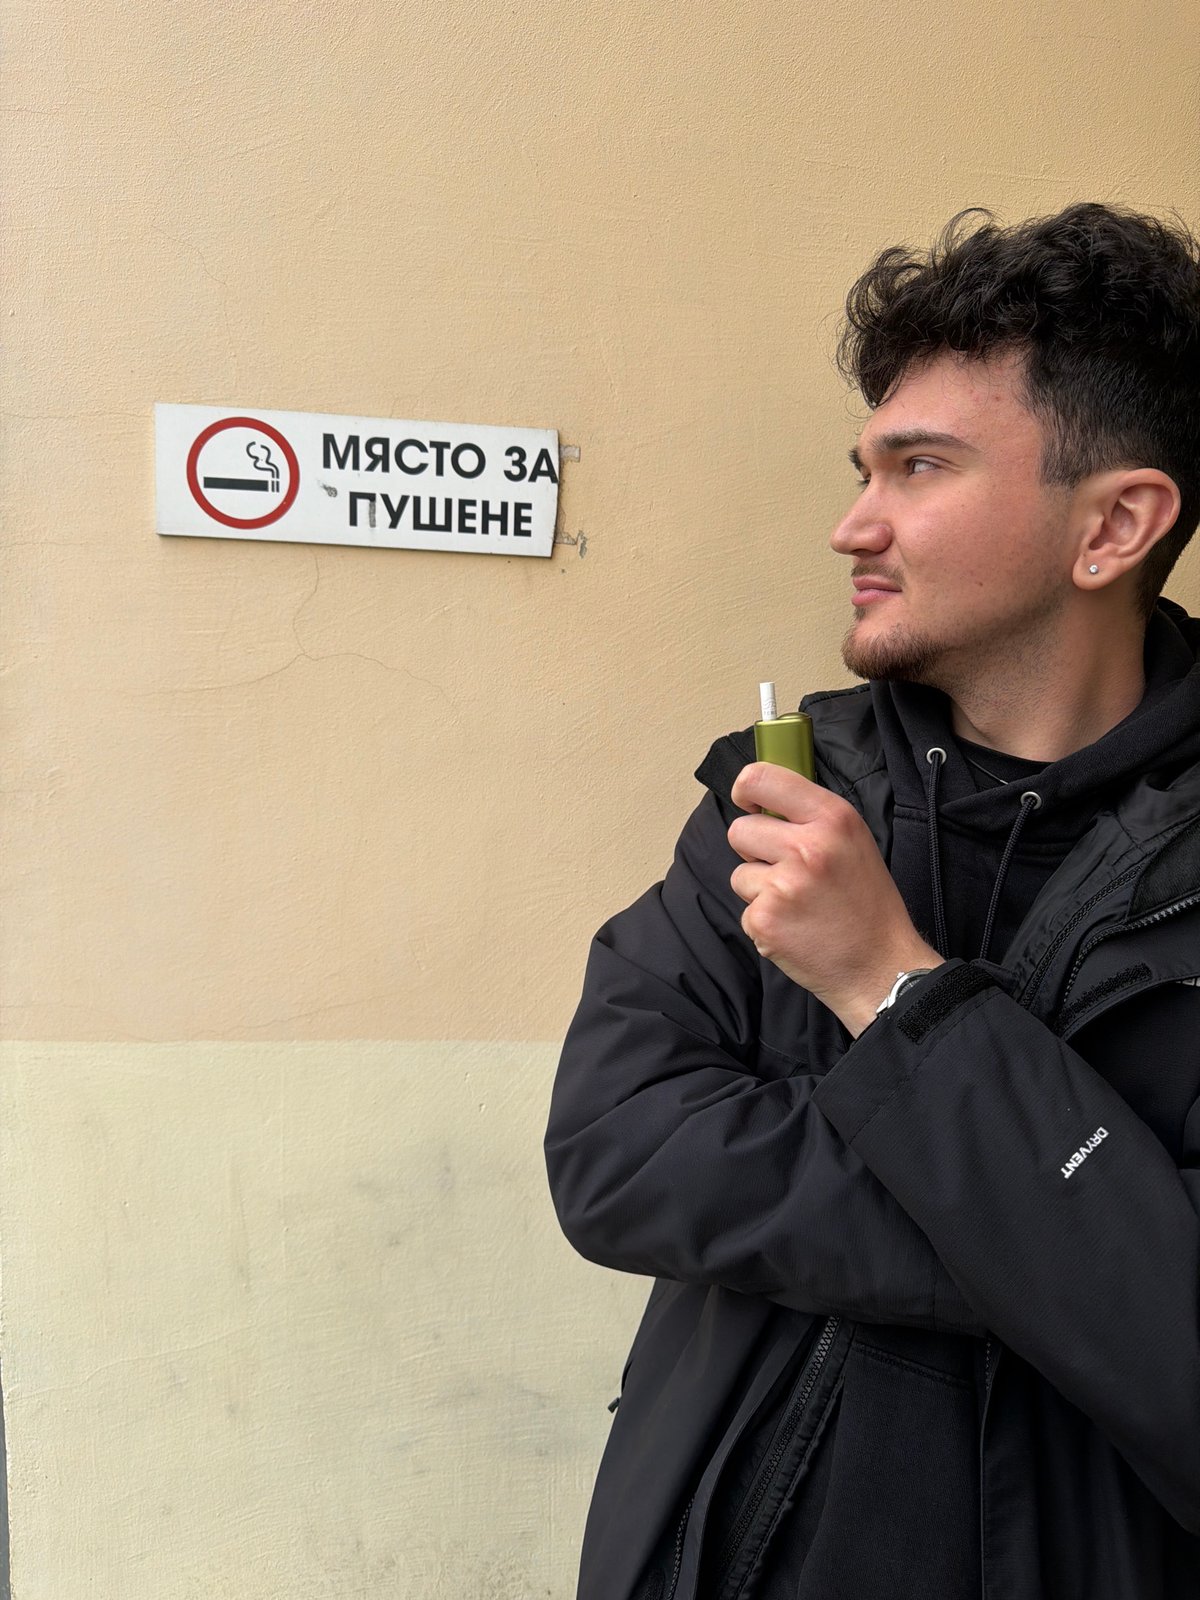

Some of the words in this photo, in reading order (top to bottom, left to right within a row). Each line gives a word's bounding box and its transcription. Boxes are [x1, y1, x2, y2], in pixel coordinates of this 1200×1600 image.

[322, 433, 486, 479] МЯСТО
[503, 445, 559, 484] ЗА
[348, 491, 533, 538] ПУШЕНЕ
[1060, 1127, 1109, 1179] DRYVENT
